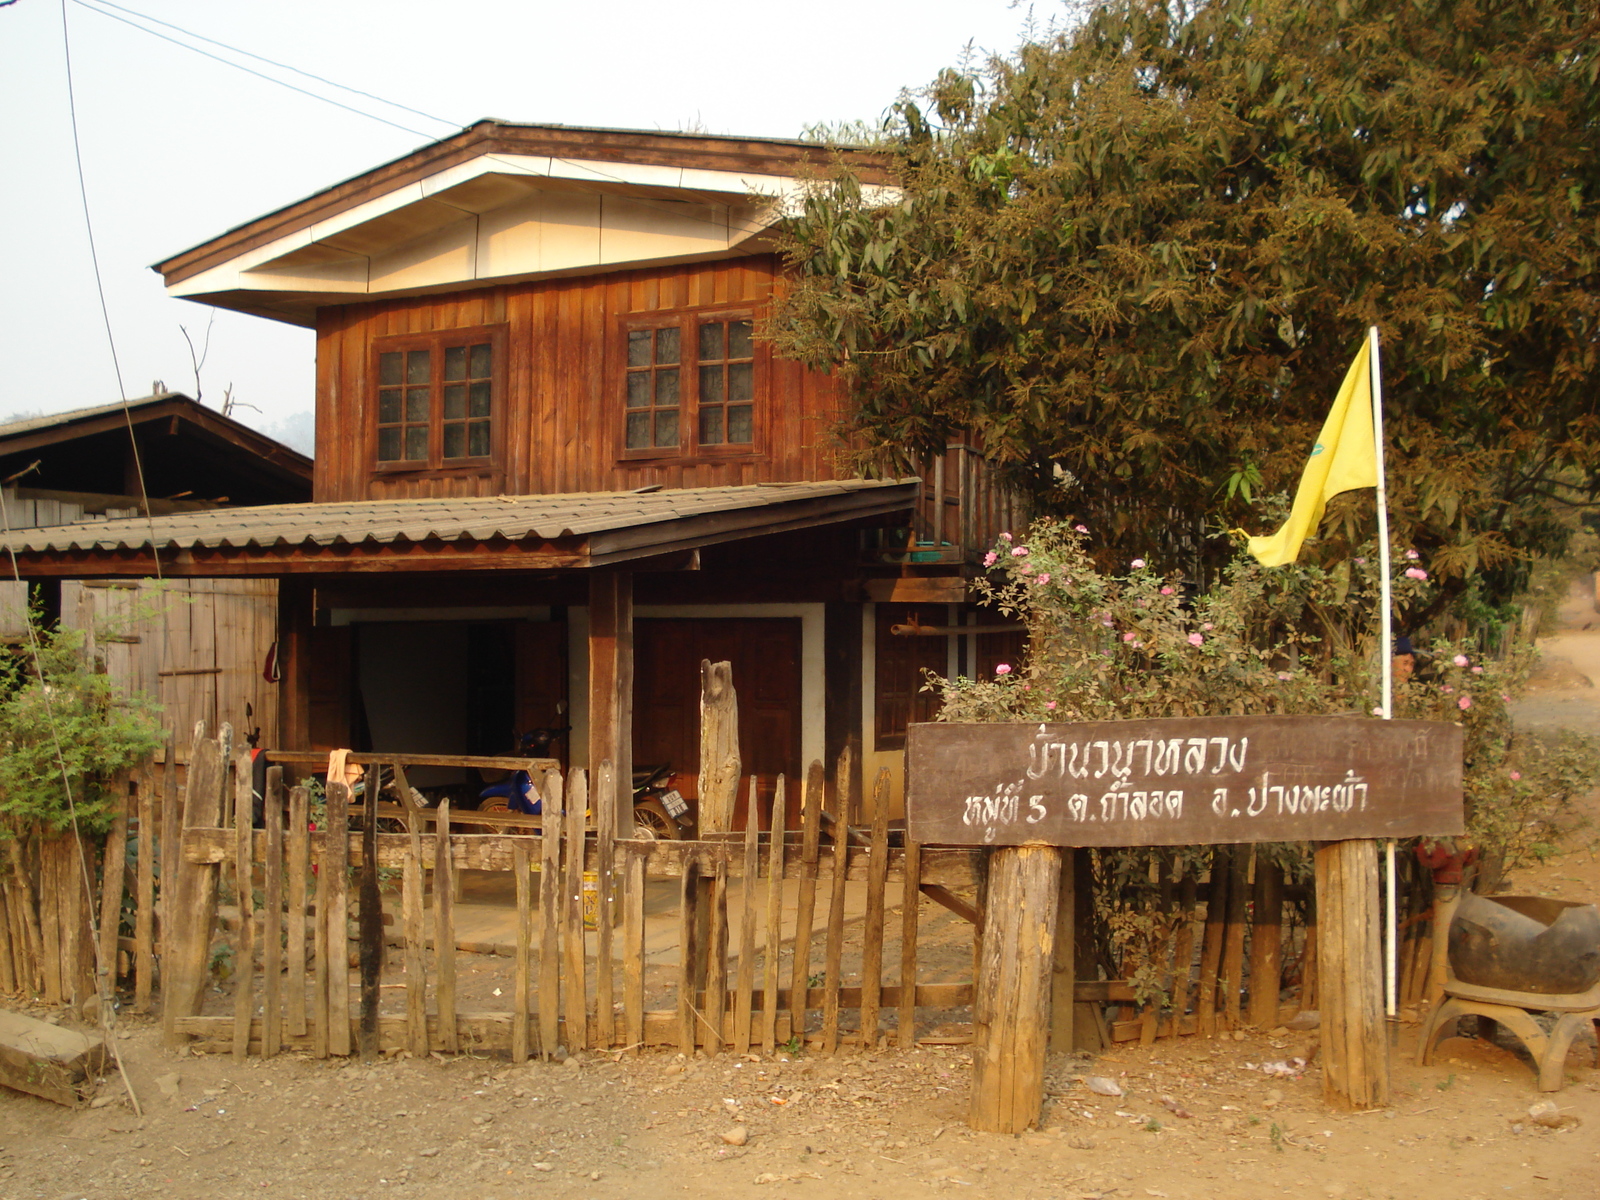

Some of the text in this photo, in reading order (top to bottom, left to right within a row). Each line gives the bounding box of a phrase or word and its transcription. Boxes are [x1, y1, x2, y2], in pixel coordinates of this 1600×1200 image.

[1026, 723, 1248, 780] บ้านวนาหลวง
[962, 778, 1025, 843] หมู่ที่
